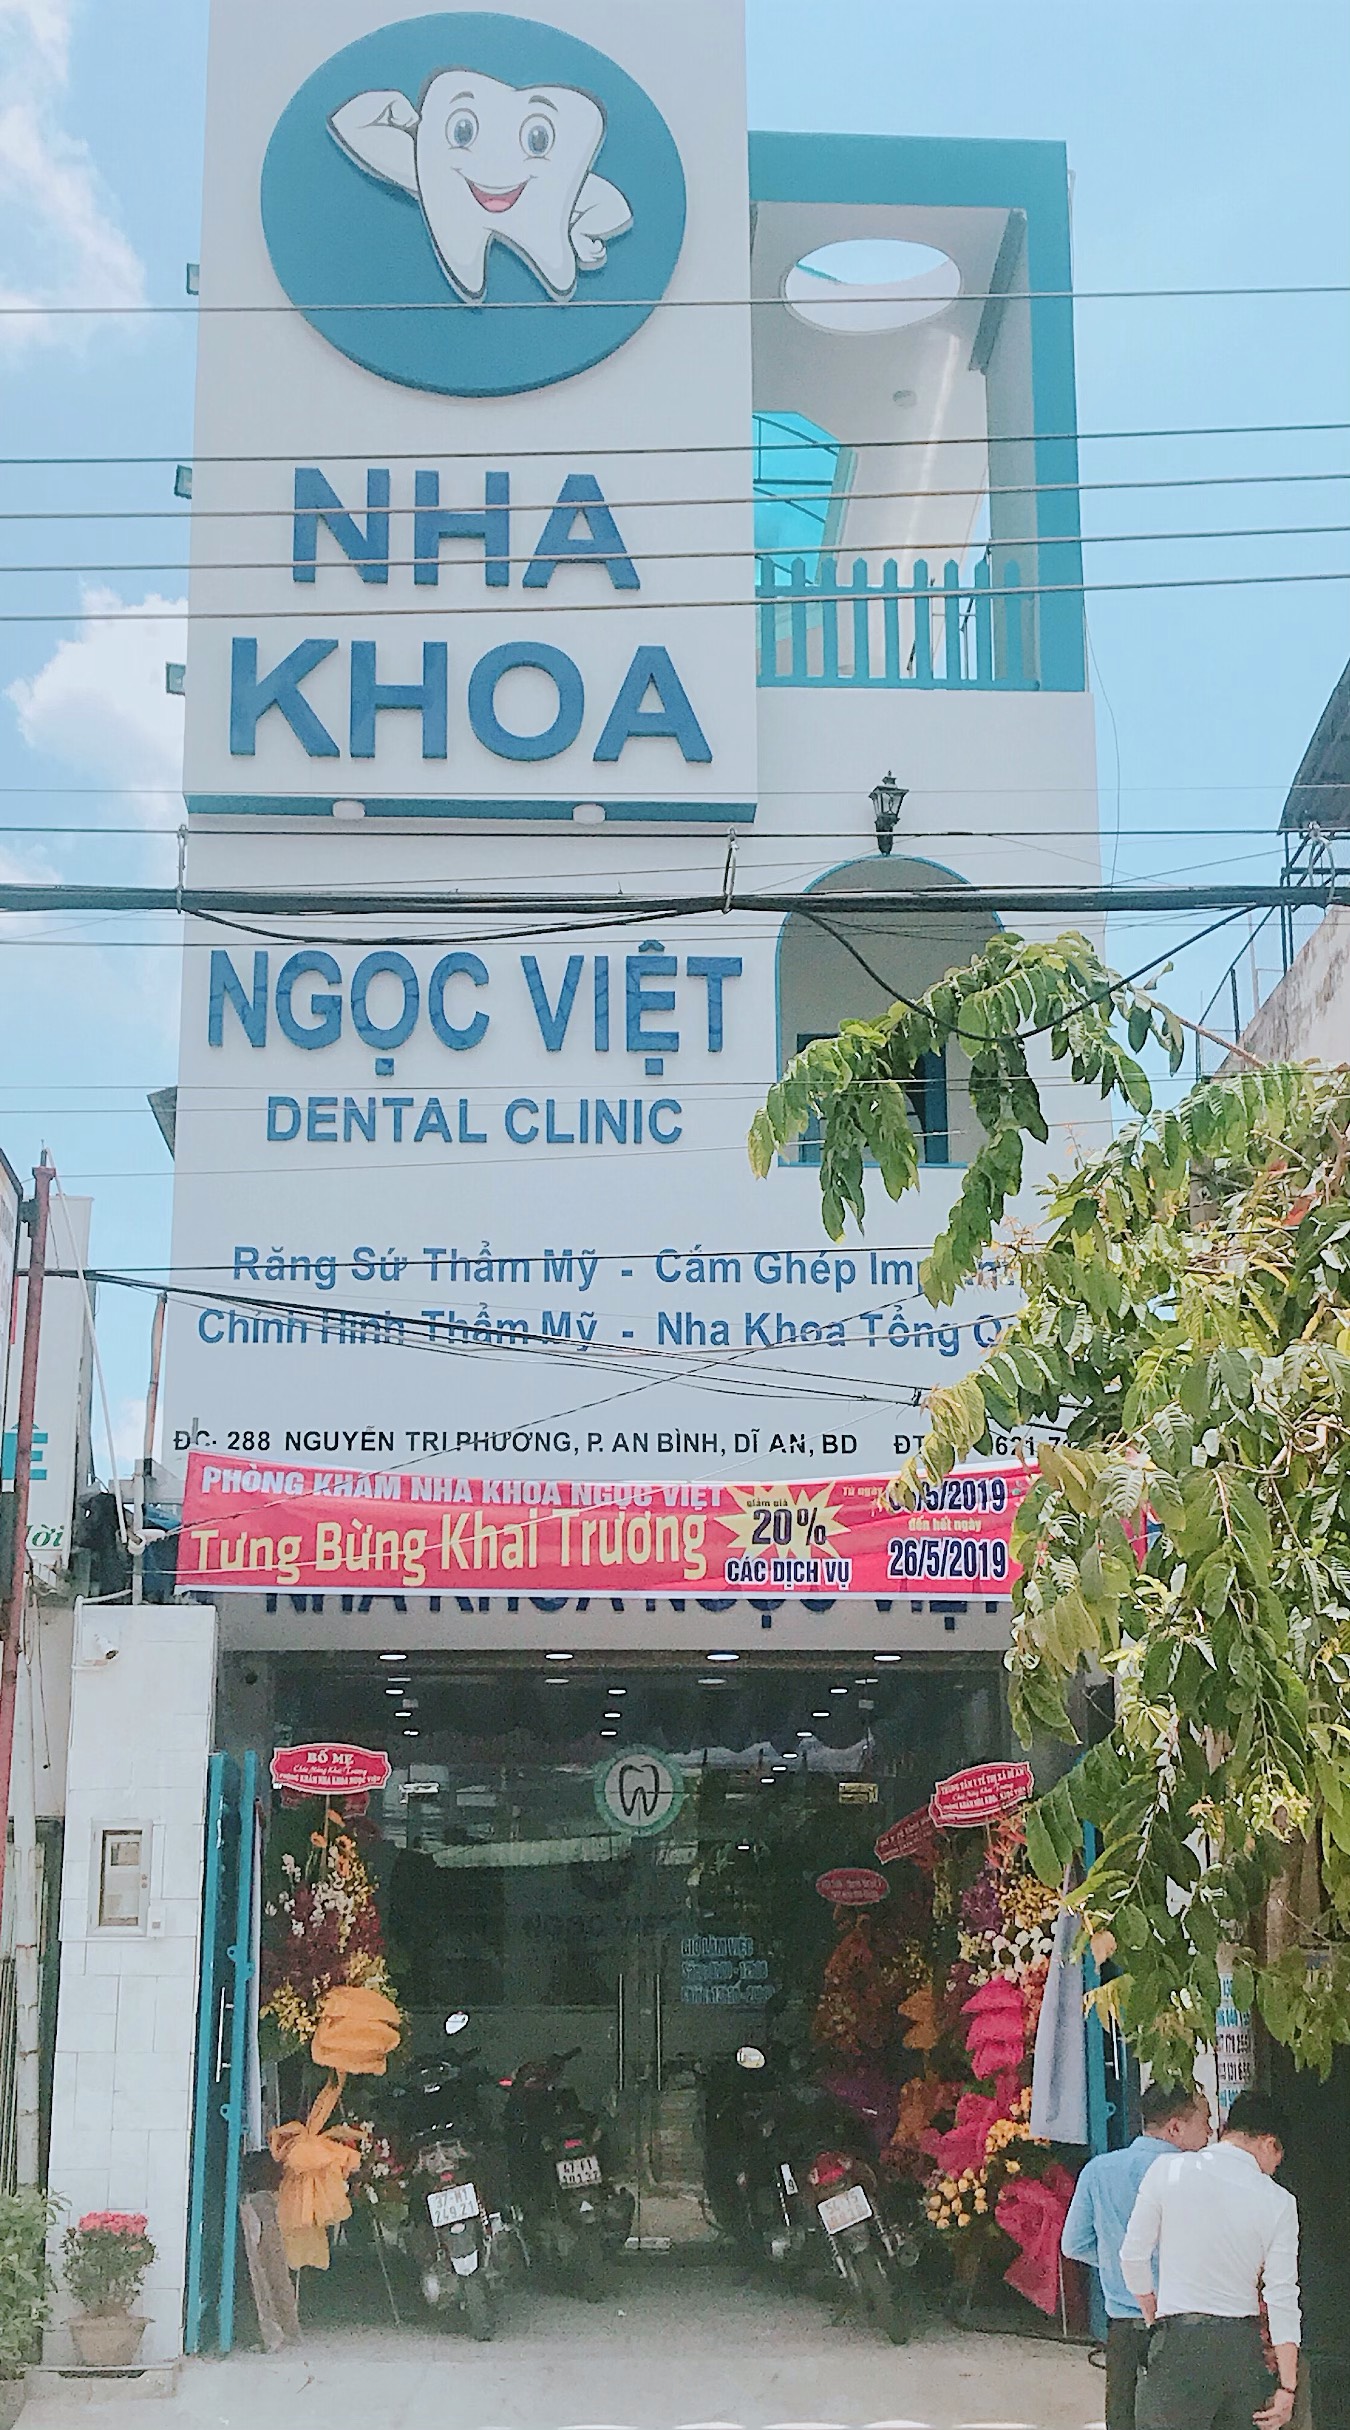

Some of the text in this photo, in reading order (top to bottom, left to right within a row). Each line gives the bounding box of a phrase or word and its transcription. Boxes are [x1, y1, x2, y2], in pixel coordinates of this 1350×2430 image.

[292, 467, 641, 590] NHA
[229, 637, 713, 763] KHOA
[208, 938, 743, 1077] NGỌC VIỆT
[266, 1095, 683, 1145] DENTAL CLINIC
[233, 1246, 337, 1291] Răng
[352, 1246, 408, 1282] Sứ
[422, 1240, 530, 1283] Thẩm
[543, 1248, 598, 1292] Mỹ
[754, 1249, 856, 1293] Ghép
[421, 1302, 529, 1345] Thẩm
[541, 1311, 598, 1351] Mỹ
[658, 1312, 729, 1346] Nha
[745, 1312, 846, 1347] Khoa
[860, 1304, 960, 1358] Tổng
[228, 1431, 271, 1451] 288
[285, 1425, 394, 1451] NGUYỄN
[406, 1431, 447, 1451] TRI
[457, 1431, 579, 1455] PHƯƠNG,
[612, 1433, 648, 1453] AN
[658, 1428, 726, 1457] BÌNH,
[735, 1429, 760, 1453] DĨ
[769, 1433, 814, 1457] AN,
[823, 1434, 858, 1454] BD
[202, 1463, 305, 1496] PHÒNG
[313, 1470, 401, 1501] KHÁM
[410, 1476, 475, 1503] NHA
[480, 1479, 563, 1507] KHOA
[571, 1484, 654, 1511] NGỌC
[191, 1508, 708, 1588] Tưng Bừng Khai Trương
[751, 1507, 828, 1547] 20%
[726, 1555, 851, 1588] CÁC DỊCH VỤ
[889, 1538, 1007, 1579] 26/5/2019
